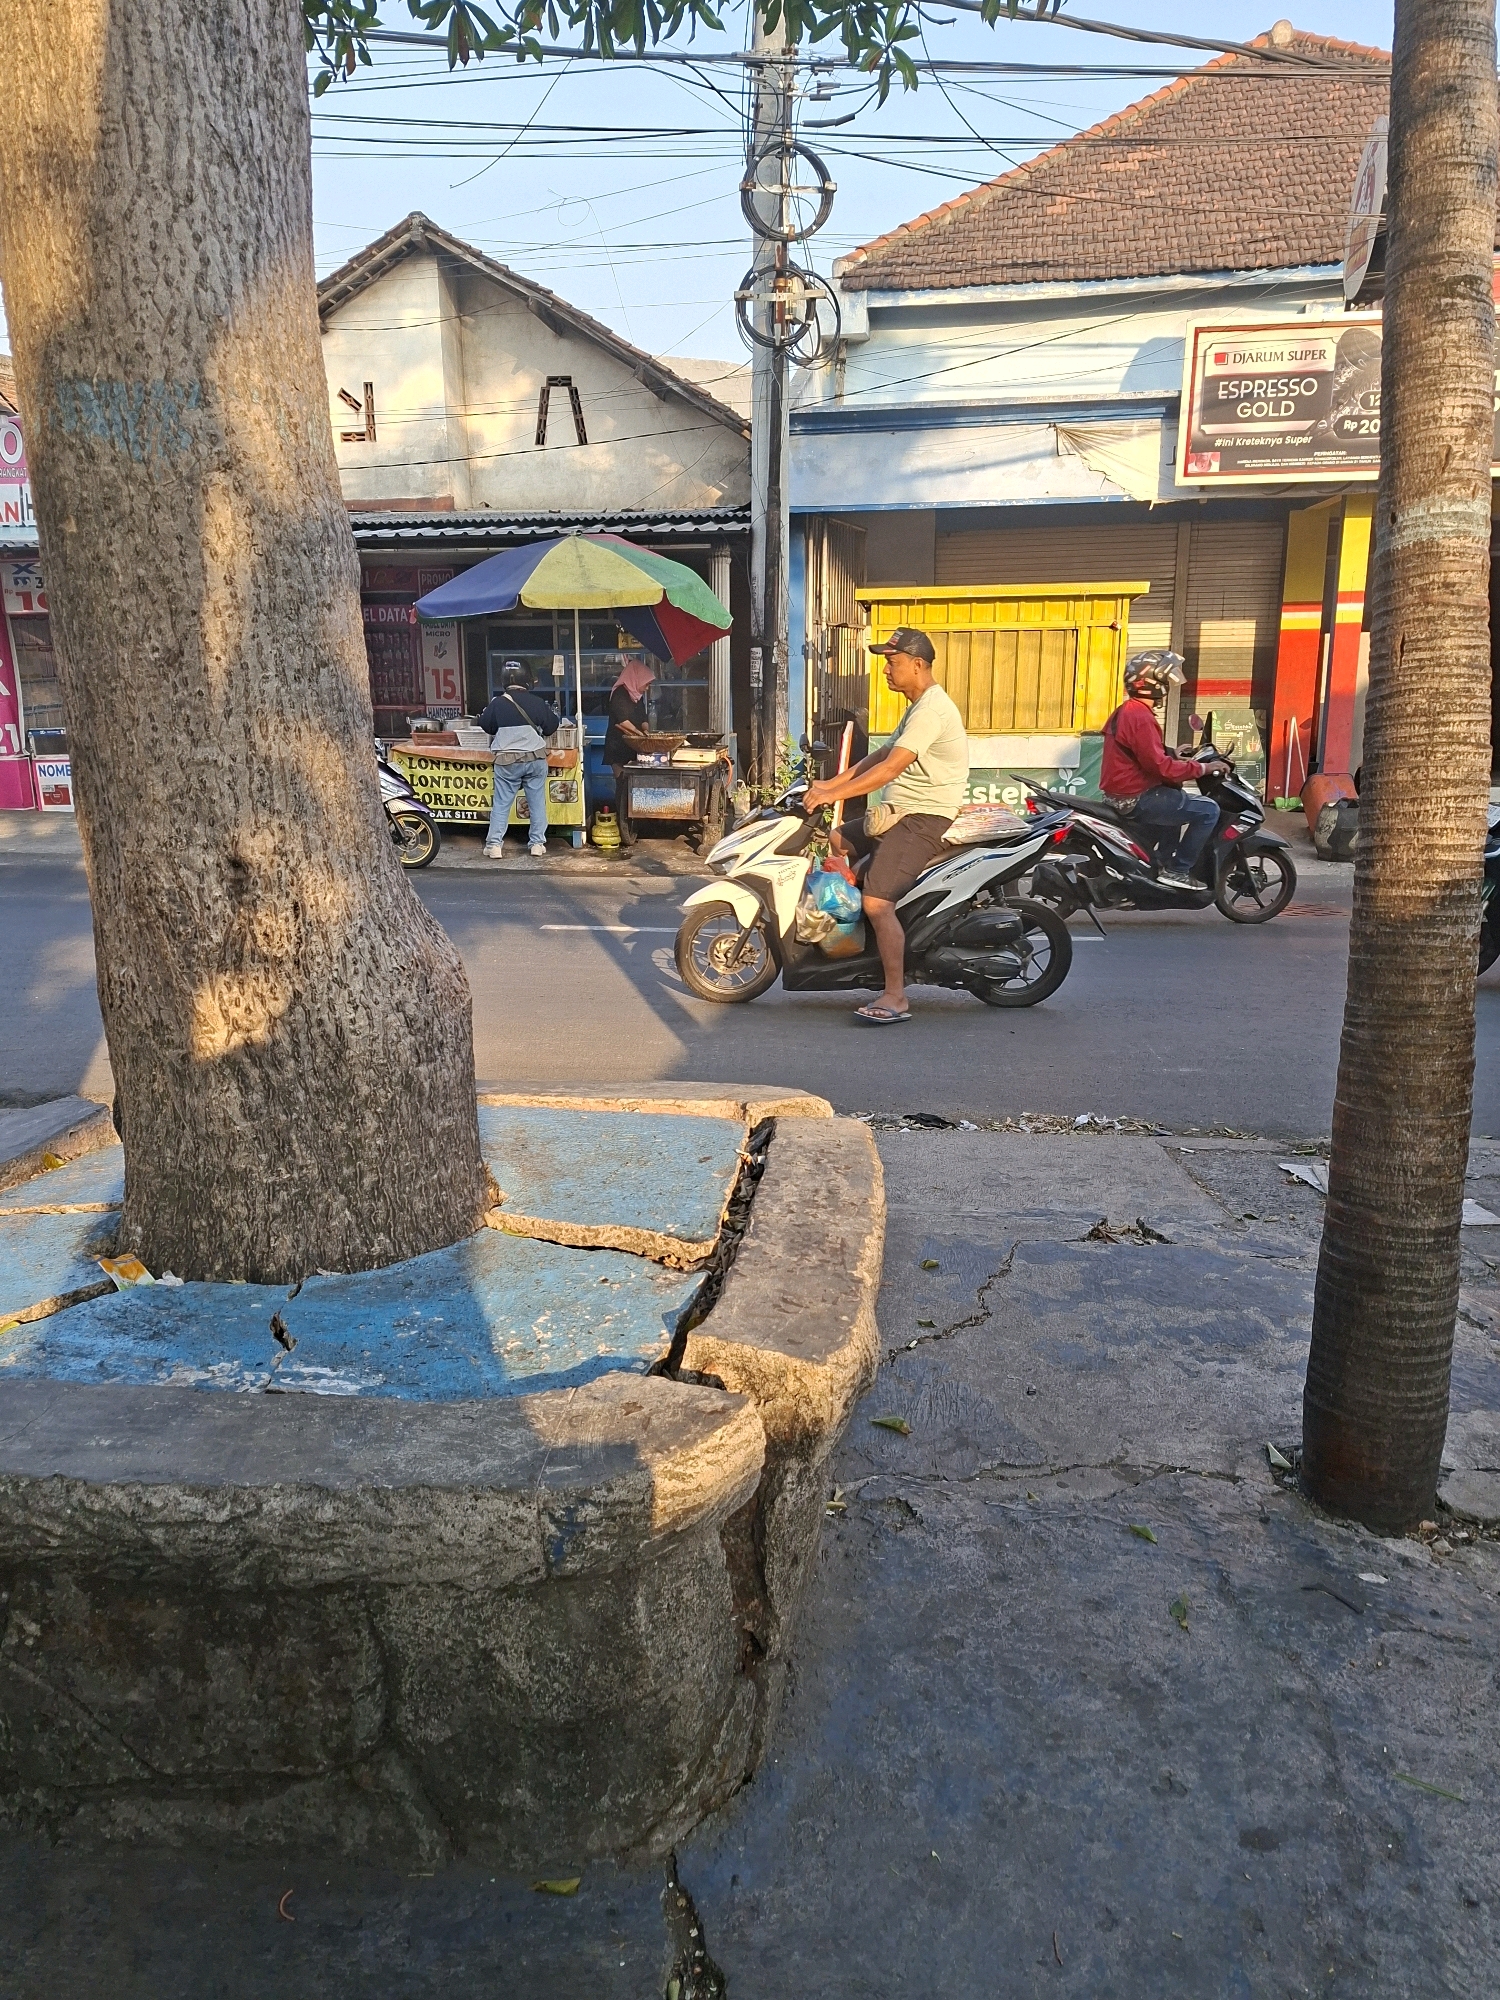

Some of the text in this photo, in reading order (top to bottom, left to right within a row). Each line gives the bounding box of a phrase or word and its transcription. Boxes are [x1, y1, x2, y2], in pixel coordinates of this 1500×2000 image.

[1233, 349, 1327, 364] DJARUM SUPER
[1218, 377, 1318, 399] ESPRESSO
[1237, 400, 1295, 417] GOLD
[1344, 420, 1357, 431] Rp
[1235, 436, 1283, 448] Kreteknya
[1285, 435, 1313, 446] Super
[421, 573, 451, 586] PROMO
[379, 608, 408, 622] DATA
[431, 668, 457, 700] 15
[407, 757, 488, 772] LONTONG
[408, 773, 489, 790] LONTONG
[412, 792, 494, 808] GORENGA
[454, 811, 478, 820] SITI
